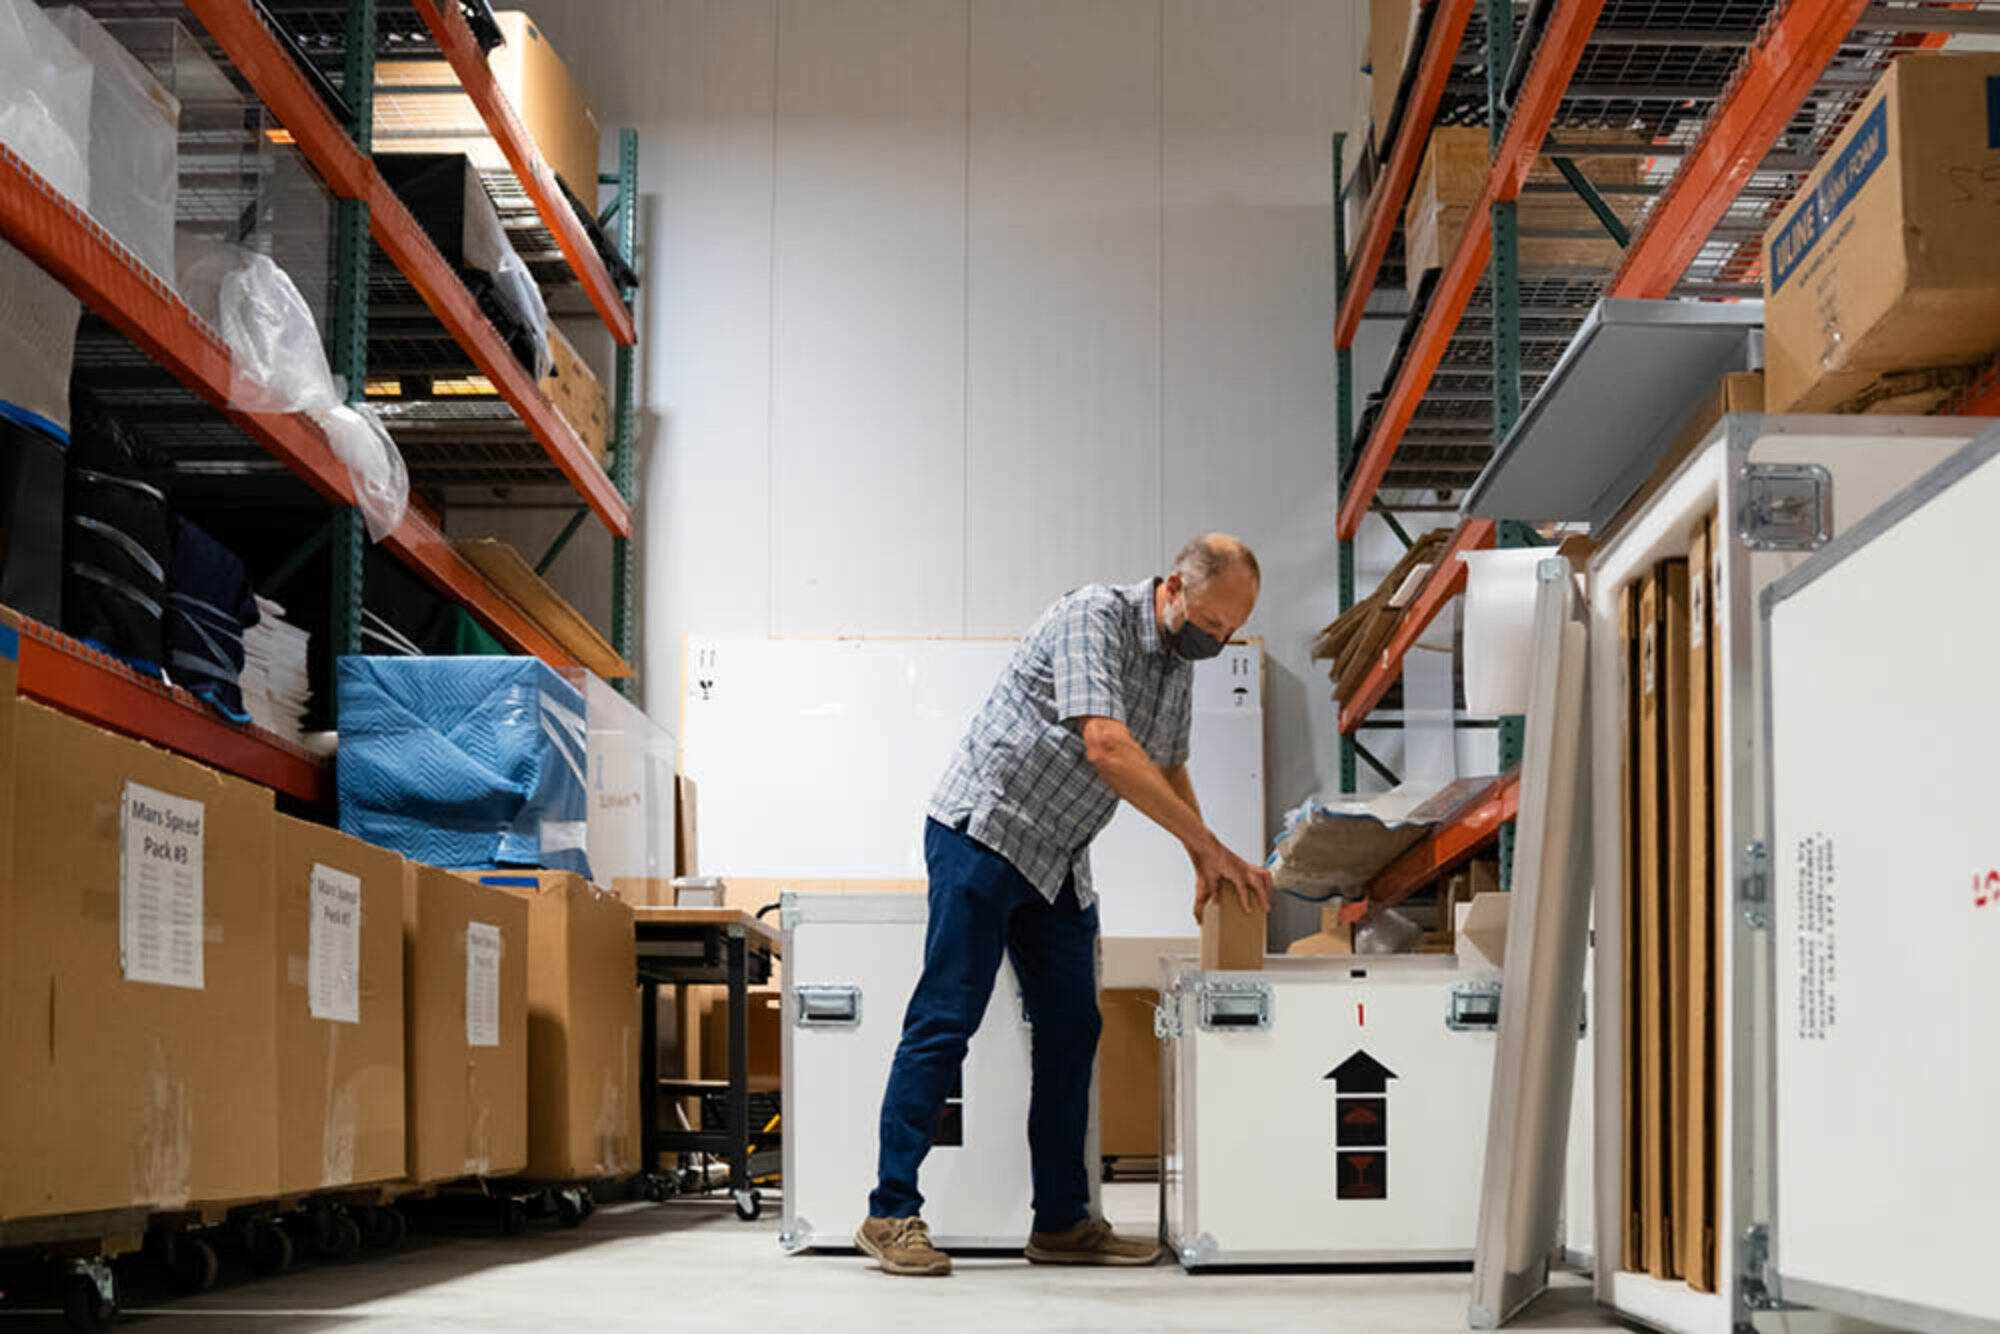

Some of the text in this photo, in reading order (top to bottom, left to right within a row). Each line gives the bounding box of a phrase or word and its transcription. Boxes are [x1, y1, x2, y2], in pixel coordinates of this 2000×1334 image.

[132, 799, 200, 836] Mars Speed
[143, 834, 172, 862] Pack
[1357, 1003, 1365, 1027] 1
